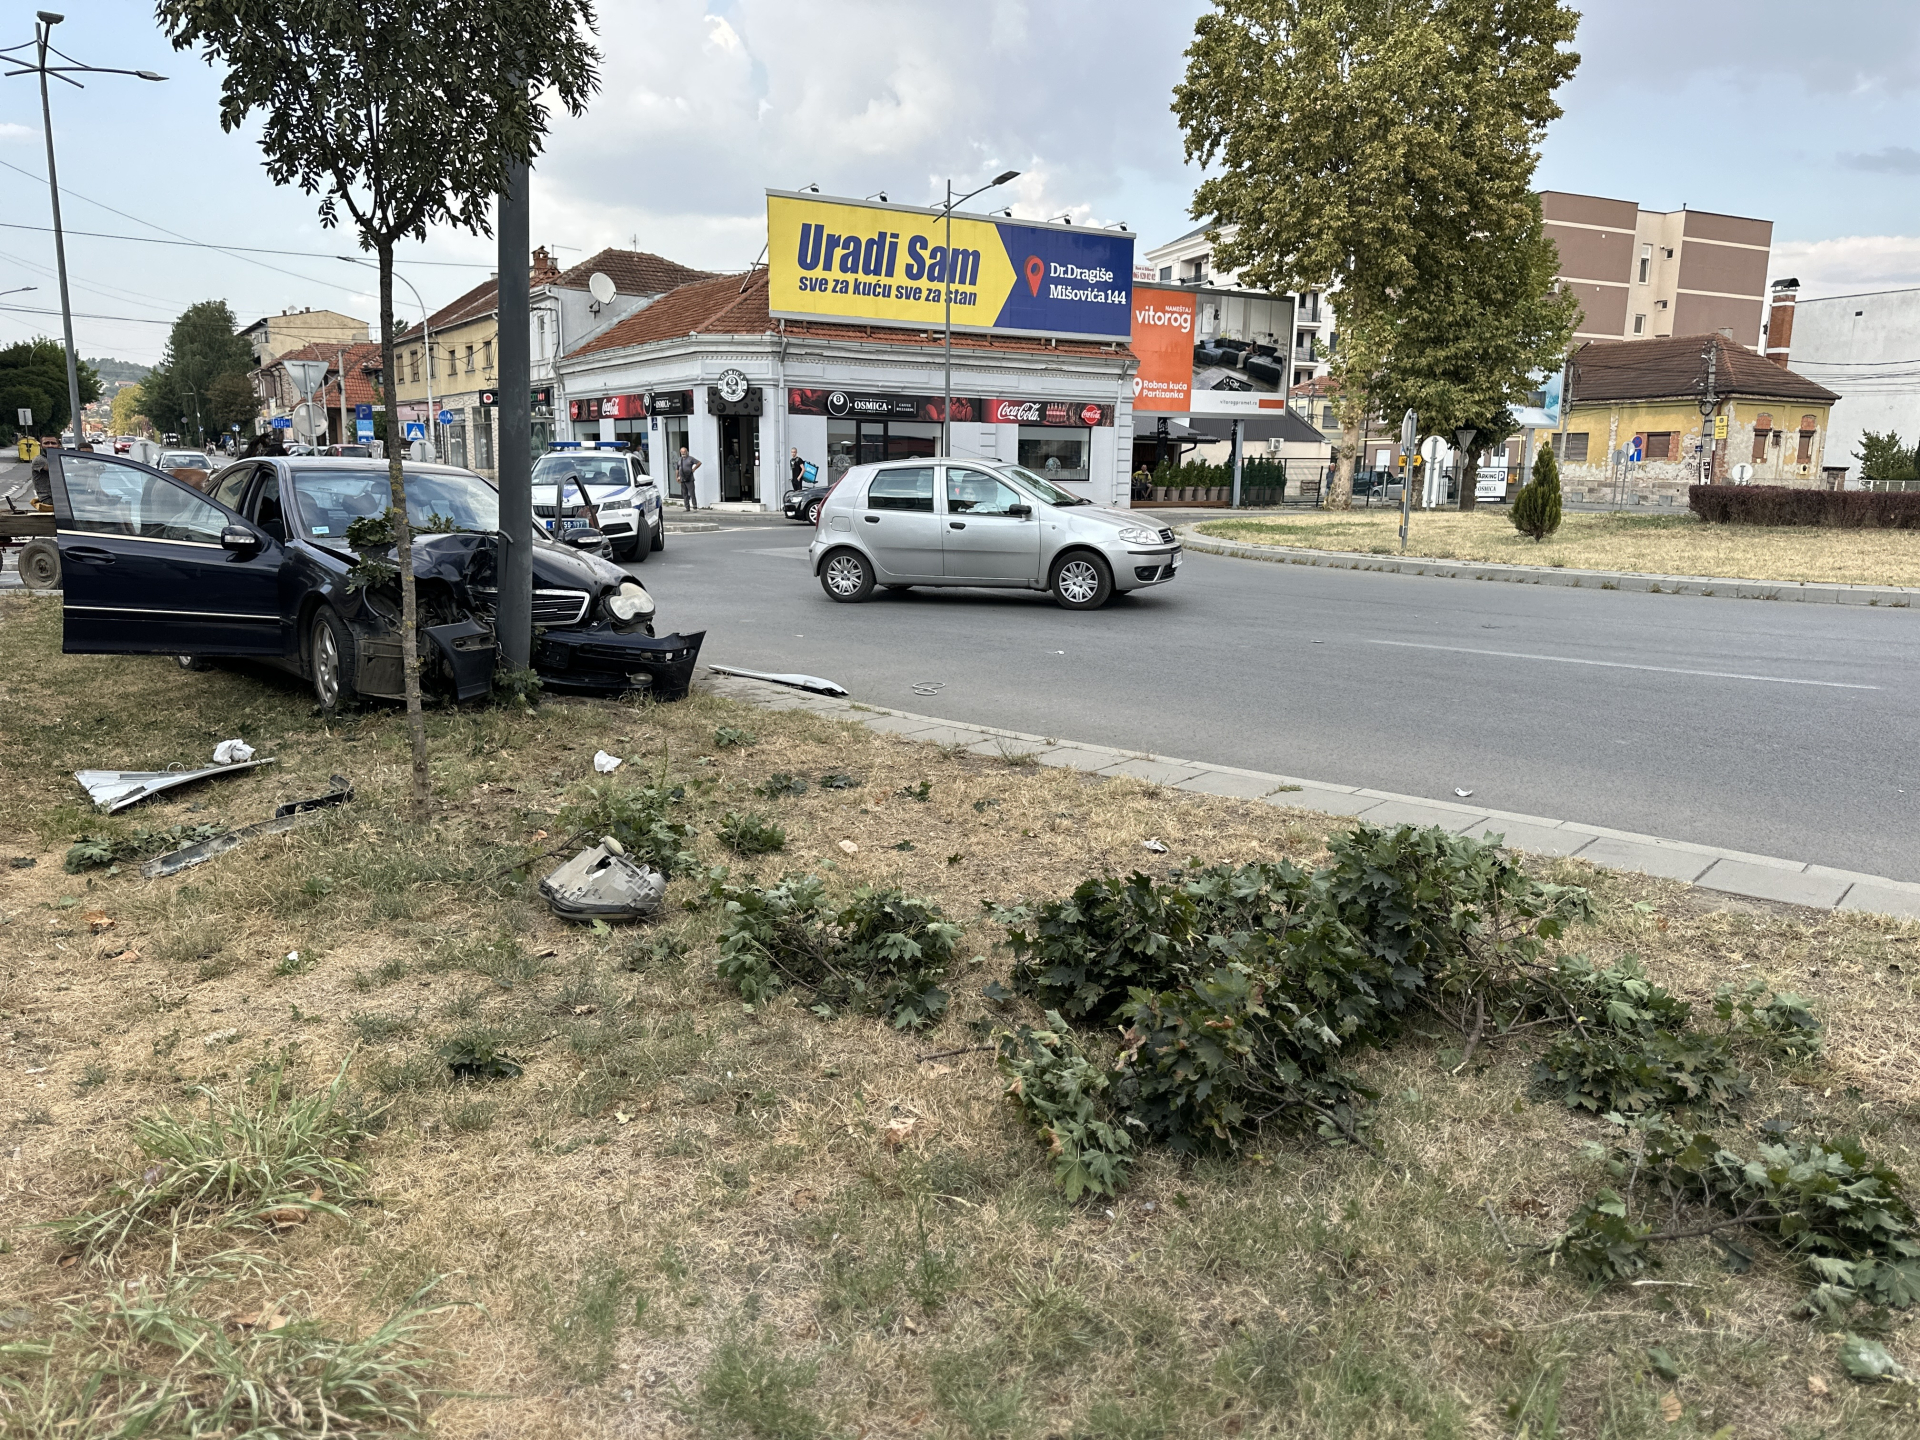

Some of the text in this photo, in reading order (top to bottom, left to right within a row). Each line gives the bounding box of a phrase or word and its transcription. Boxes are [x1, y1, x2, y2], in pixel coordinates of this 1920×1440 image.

[797, 223, 981, 286] Uradi Sam
[1050, 262, 1113, 283] Dr.Dragiše
[799, 277, 829, 292] sve
[832, 279, 849, 294] za
[853, 278, 892, 298] kuću
[895, 285, 922, 301] sve
[925, 288, 941, 303] za
[1049, 284, 1126, 304] Mišovića 144
[1135, 305, 1191, 333] vitorog
[1165, 305, 1191, 313] NAMEŠTAJ
[1143, 380, 1188, 390] Robna kuća
[1143, 389, 1184, 399] Partizanka
[854, 400, 888, 411] OSMICA
[997, 401, 1041, 421] Coca-Cola
